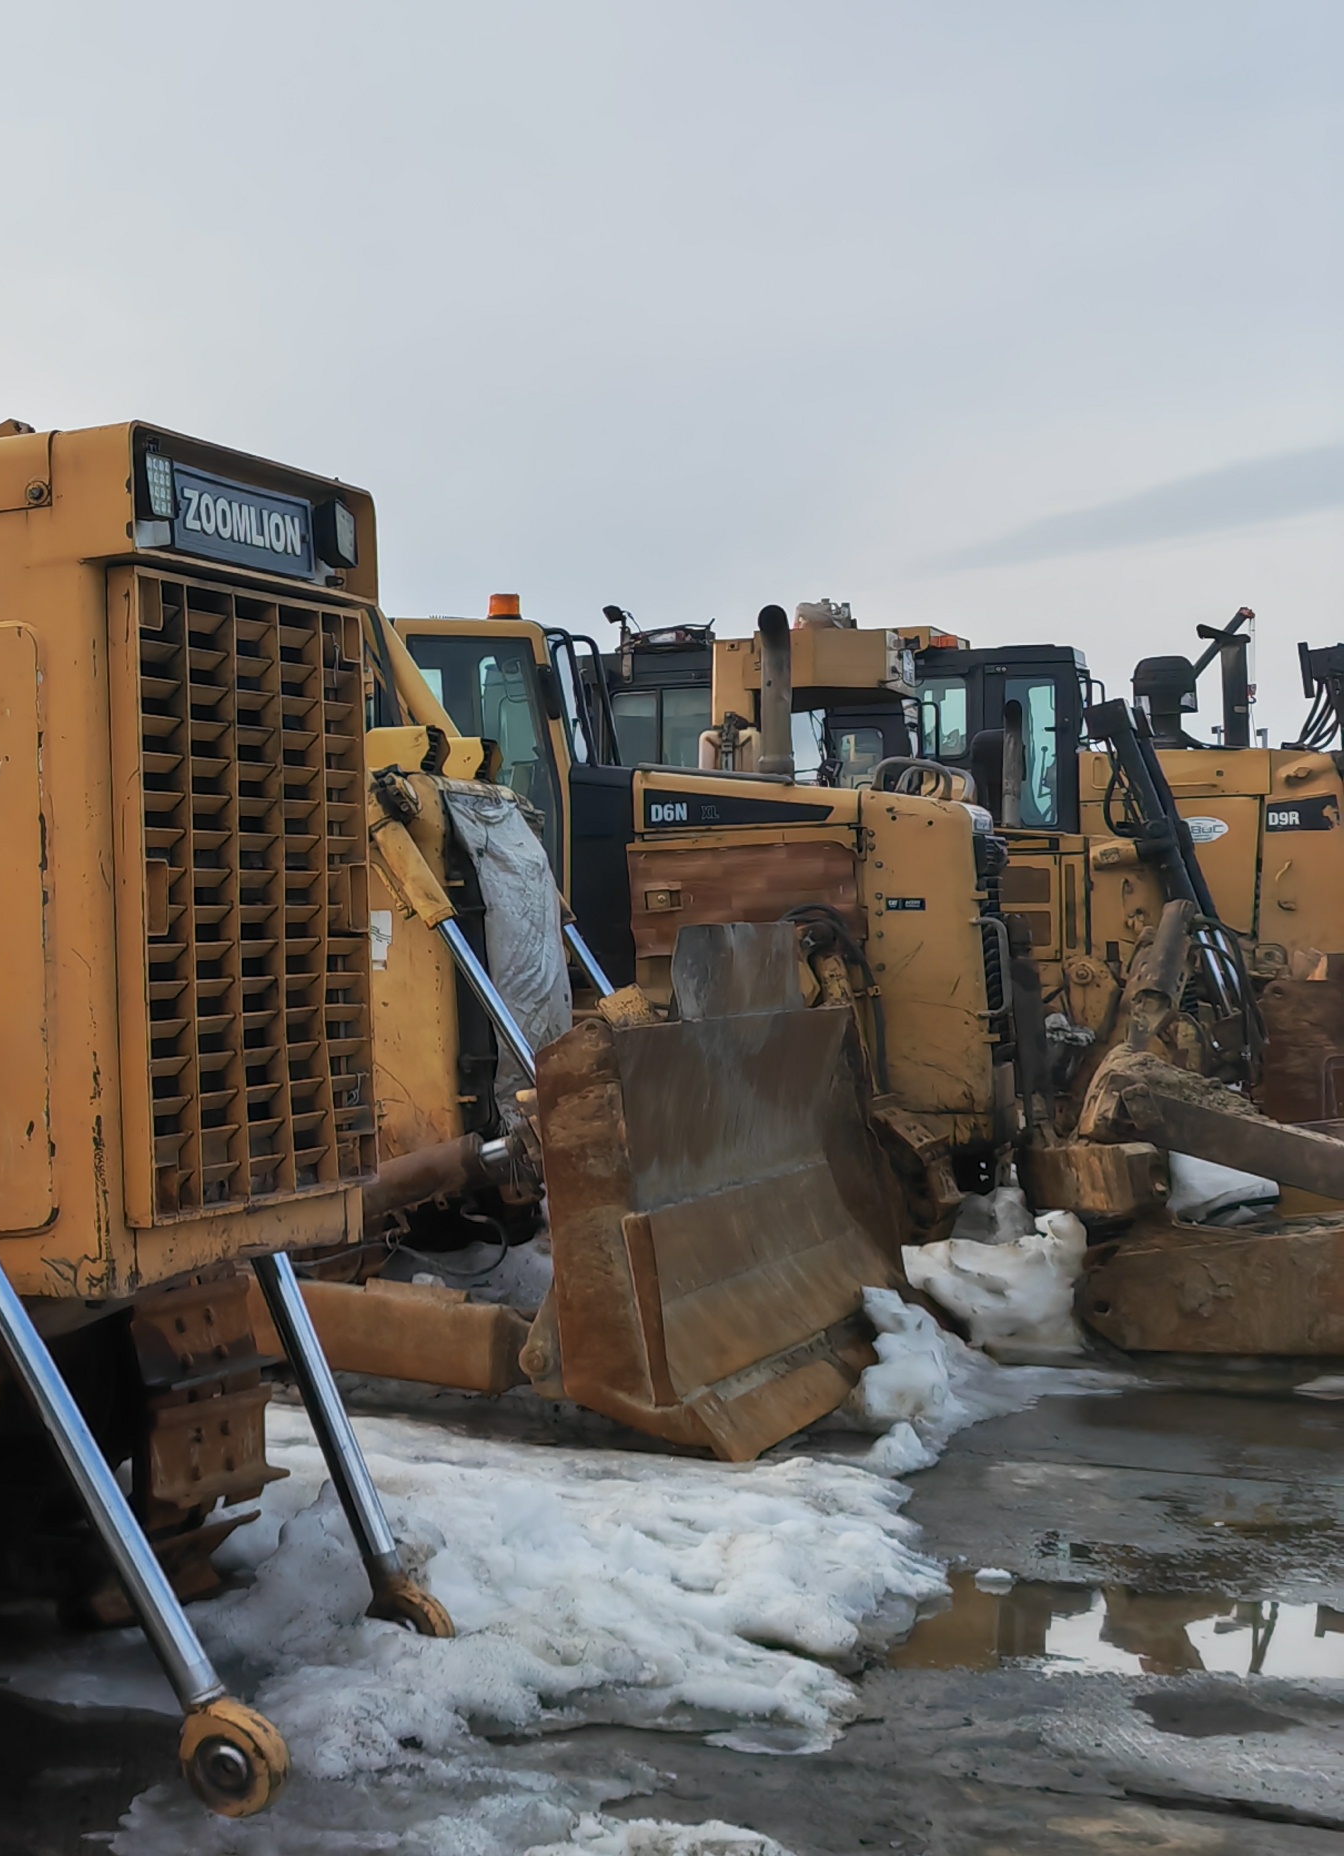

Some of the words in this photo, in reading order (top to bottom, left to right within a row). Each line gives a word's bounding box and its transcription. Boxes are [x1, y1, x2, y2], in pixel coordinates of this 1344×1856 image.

[181, 487, 302, 556] ZOOMLION
[650, 803, 688, 823] D6N
[1268, 811, 1301, 826] D9R
